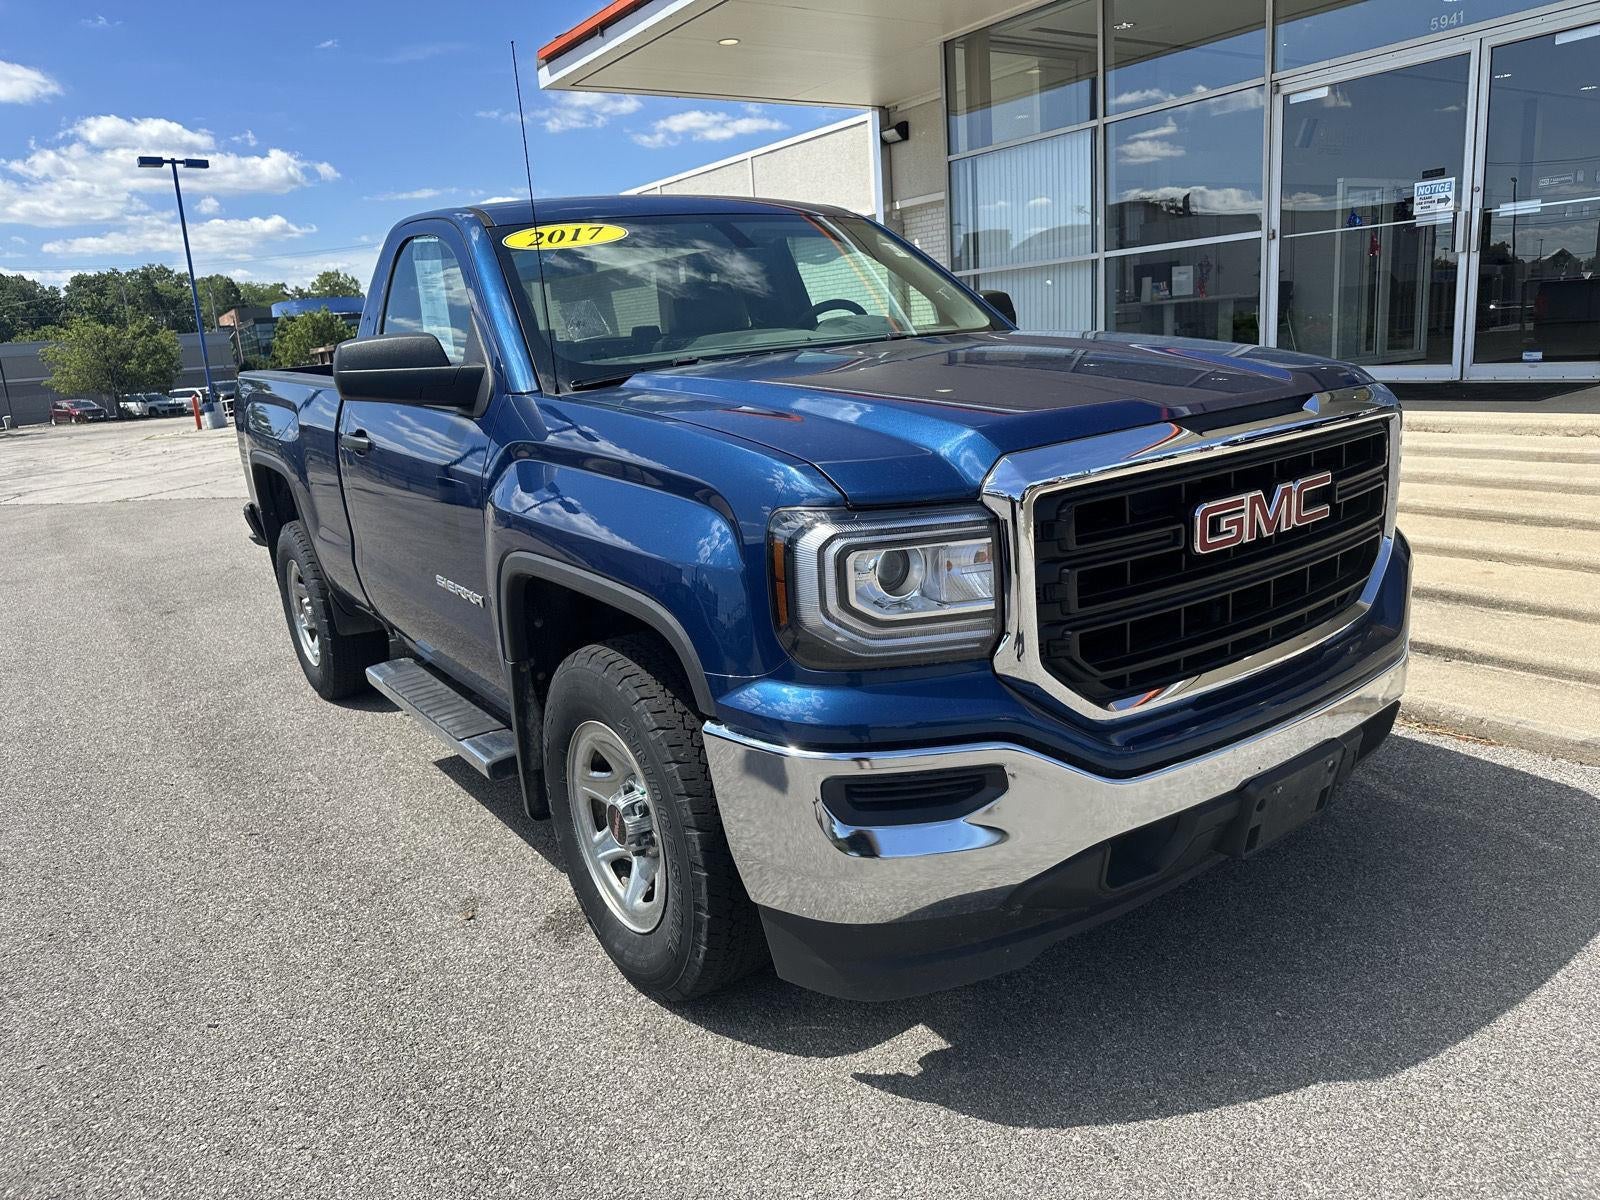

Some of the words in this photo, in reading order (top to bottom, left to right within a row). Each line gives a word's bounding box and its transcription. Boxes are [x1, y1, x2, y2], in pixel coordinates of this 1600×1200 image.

[1431, 11, 1463, 30] 5941
[1418, 183, 1450, 195] NOTICE
[527, 226, 604, 247] 2017
[1194, 470, 1332, 554] GMC
[435, 574, 484, 608] SIERRA
[618, 716, 685, 959] BRIDGESTONE
